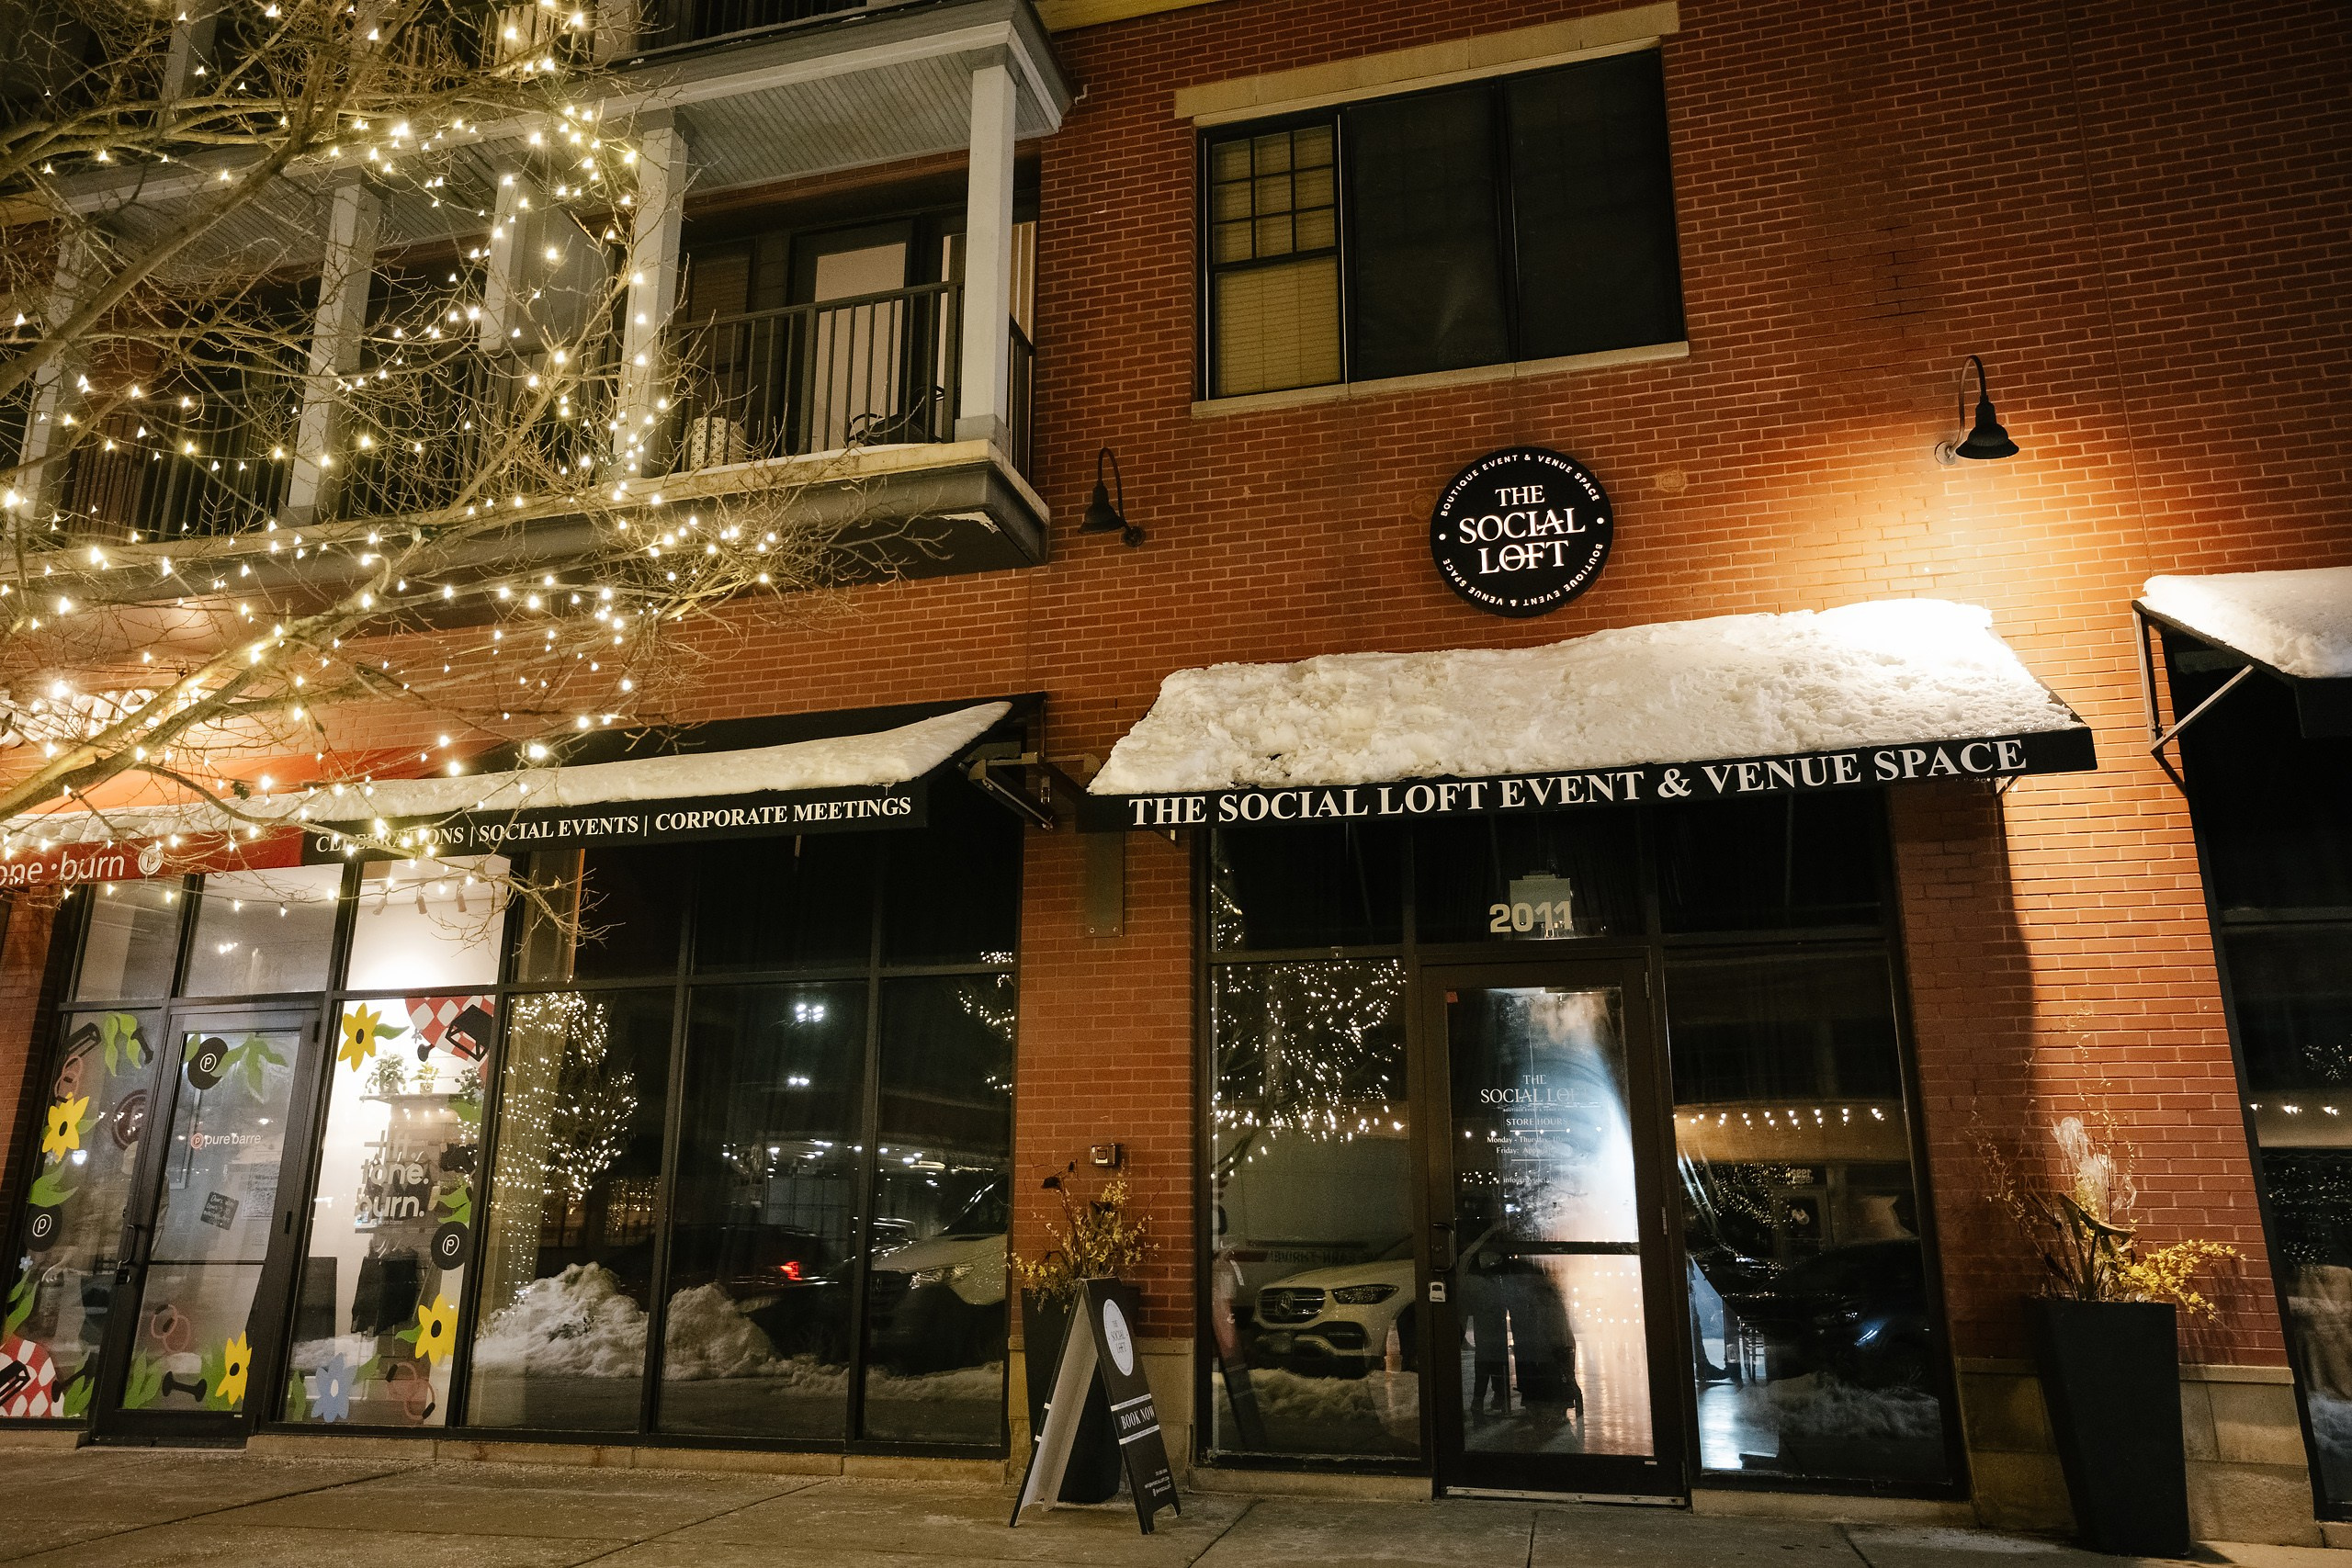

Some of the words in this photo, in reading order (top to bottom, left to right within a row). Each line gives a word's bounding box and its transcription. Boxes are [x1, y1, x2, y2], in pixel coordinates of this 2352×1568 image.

[1441, 469, 1480, 517] BOUTIQUE
[1482, 455, 1518, 471] EVENT
[1523, 454, 1532, 462] &
[1537, 455, 1573, 474] VENUE
[1574, 472, 1600, 502] SPACE
[1494, 484, 1545, 507] THE
[1459, 507, 1586, 544] SOCIAL
[1477, 539, 1569, 575] LOFT
[1562, 543, 1603, 592] BOUTIQUE
[1442, 558, 1468, 588] SPACE
[1467, 586, 1504, 606] VENUE
[1510, 598, 1518, 607] &
[1522, 590, 1561, 607] EVENT
[1128, 795, 1208, 826] THE
[1217, 788, 1369, 823] SOCIAL
[1377, 781, 1488, 815] LOFT
[1498, 770, 1645, 809] EVENT
[1657, 768, 1692, 798] &
[1702, 752, 1862, 794] VENUE
[1873, 739, 2028, 783] SPACE
[479, 820, 555, 841] SOCIAL
[558, 816, 639, 838] EVENTS
[655, 806, 788, 831] CORPORATE
[792, 796, 911, 822] MEETINGS
[59, 851, 125, 881] burn
[1489, 901, 1571, 932] 2011
[1522, 1074, 1547, 1085] THE
[1480, 1088, 1544, 1104] SOCIAL
[1506, 1117, 1535, 1126] STORE
[1537, 1117, 1568, 1126] HOURS
[204, 1134, 231, 1148] pure
[231, 1134, 263, 1145] barre
[1487, 1136, 1513, 1145] Monday
[1120, 1410, 1142, 1430] BOOK
[1140, 1404, 1157, 1424] NOW
